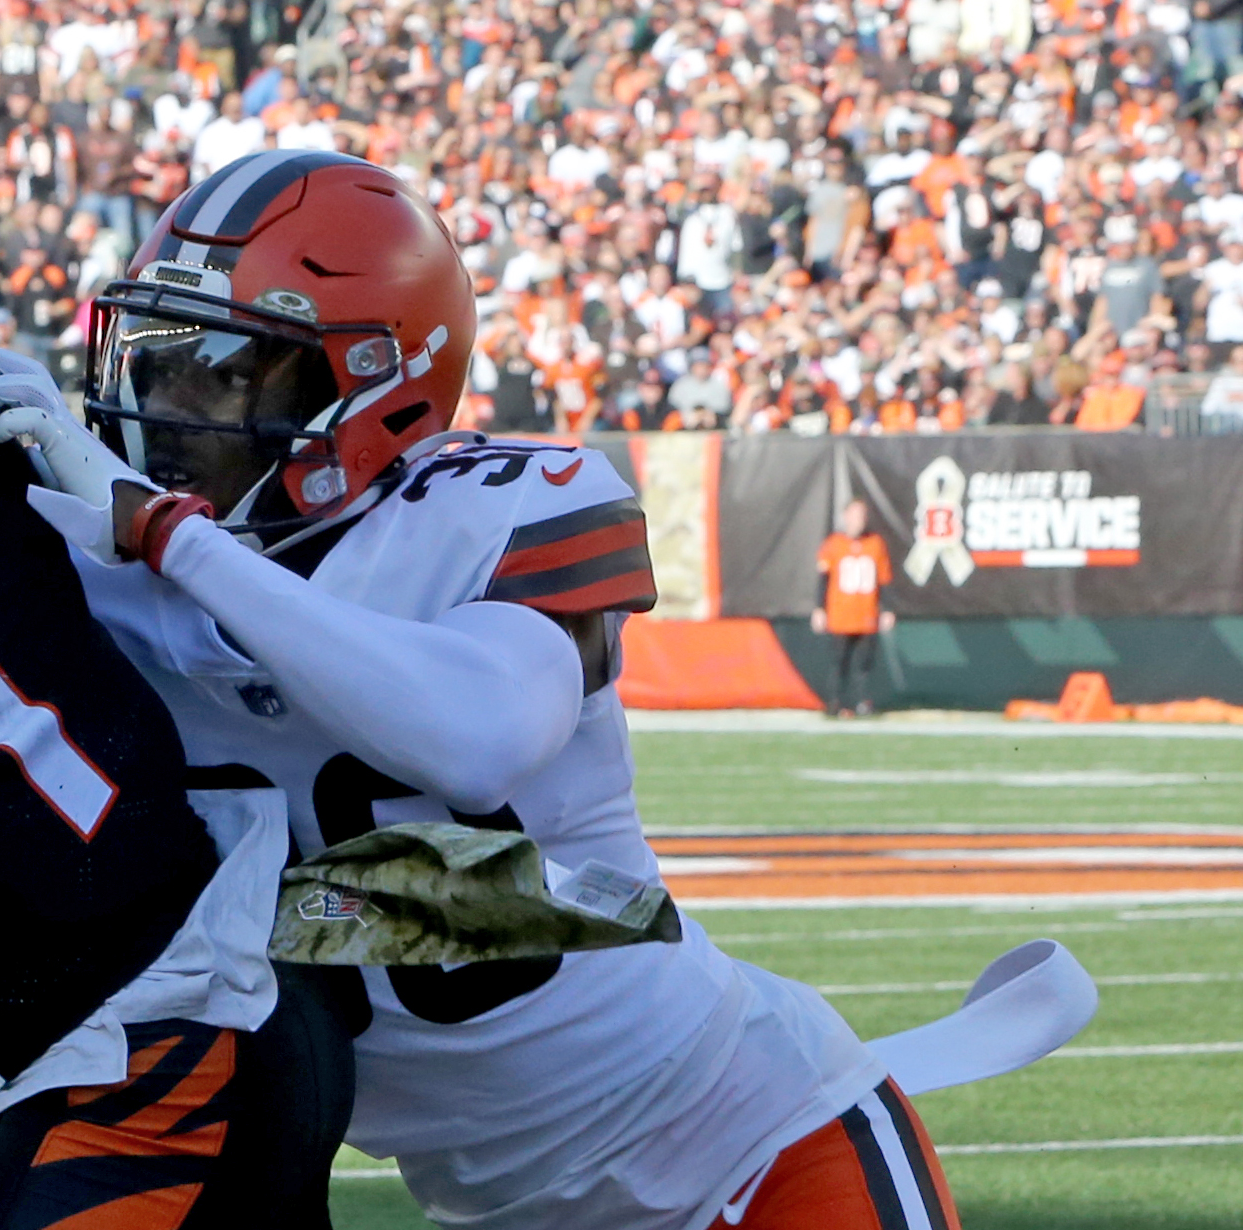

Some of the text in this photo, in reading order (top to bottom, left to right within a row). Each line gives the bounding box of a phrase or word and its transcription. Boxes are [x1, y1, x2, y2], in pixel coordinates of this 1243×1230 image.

[967, 470, 1092, 500] SALUTE TO
[965, 496, 1141, 549] SERVICE
